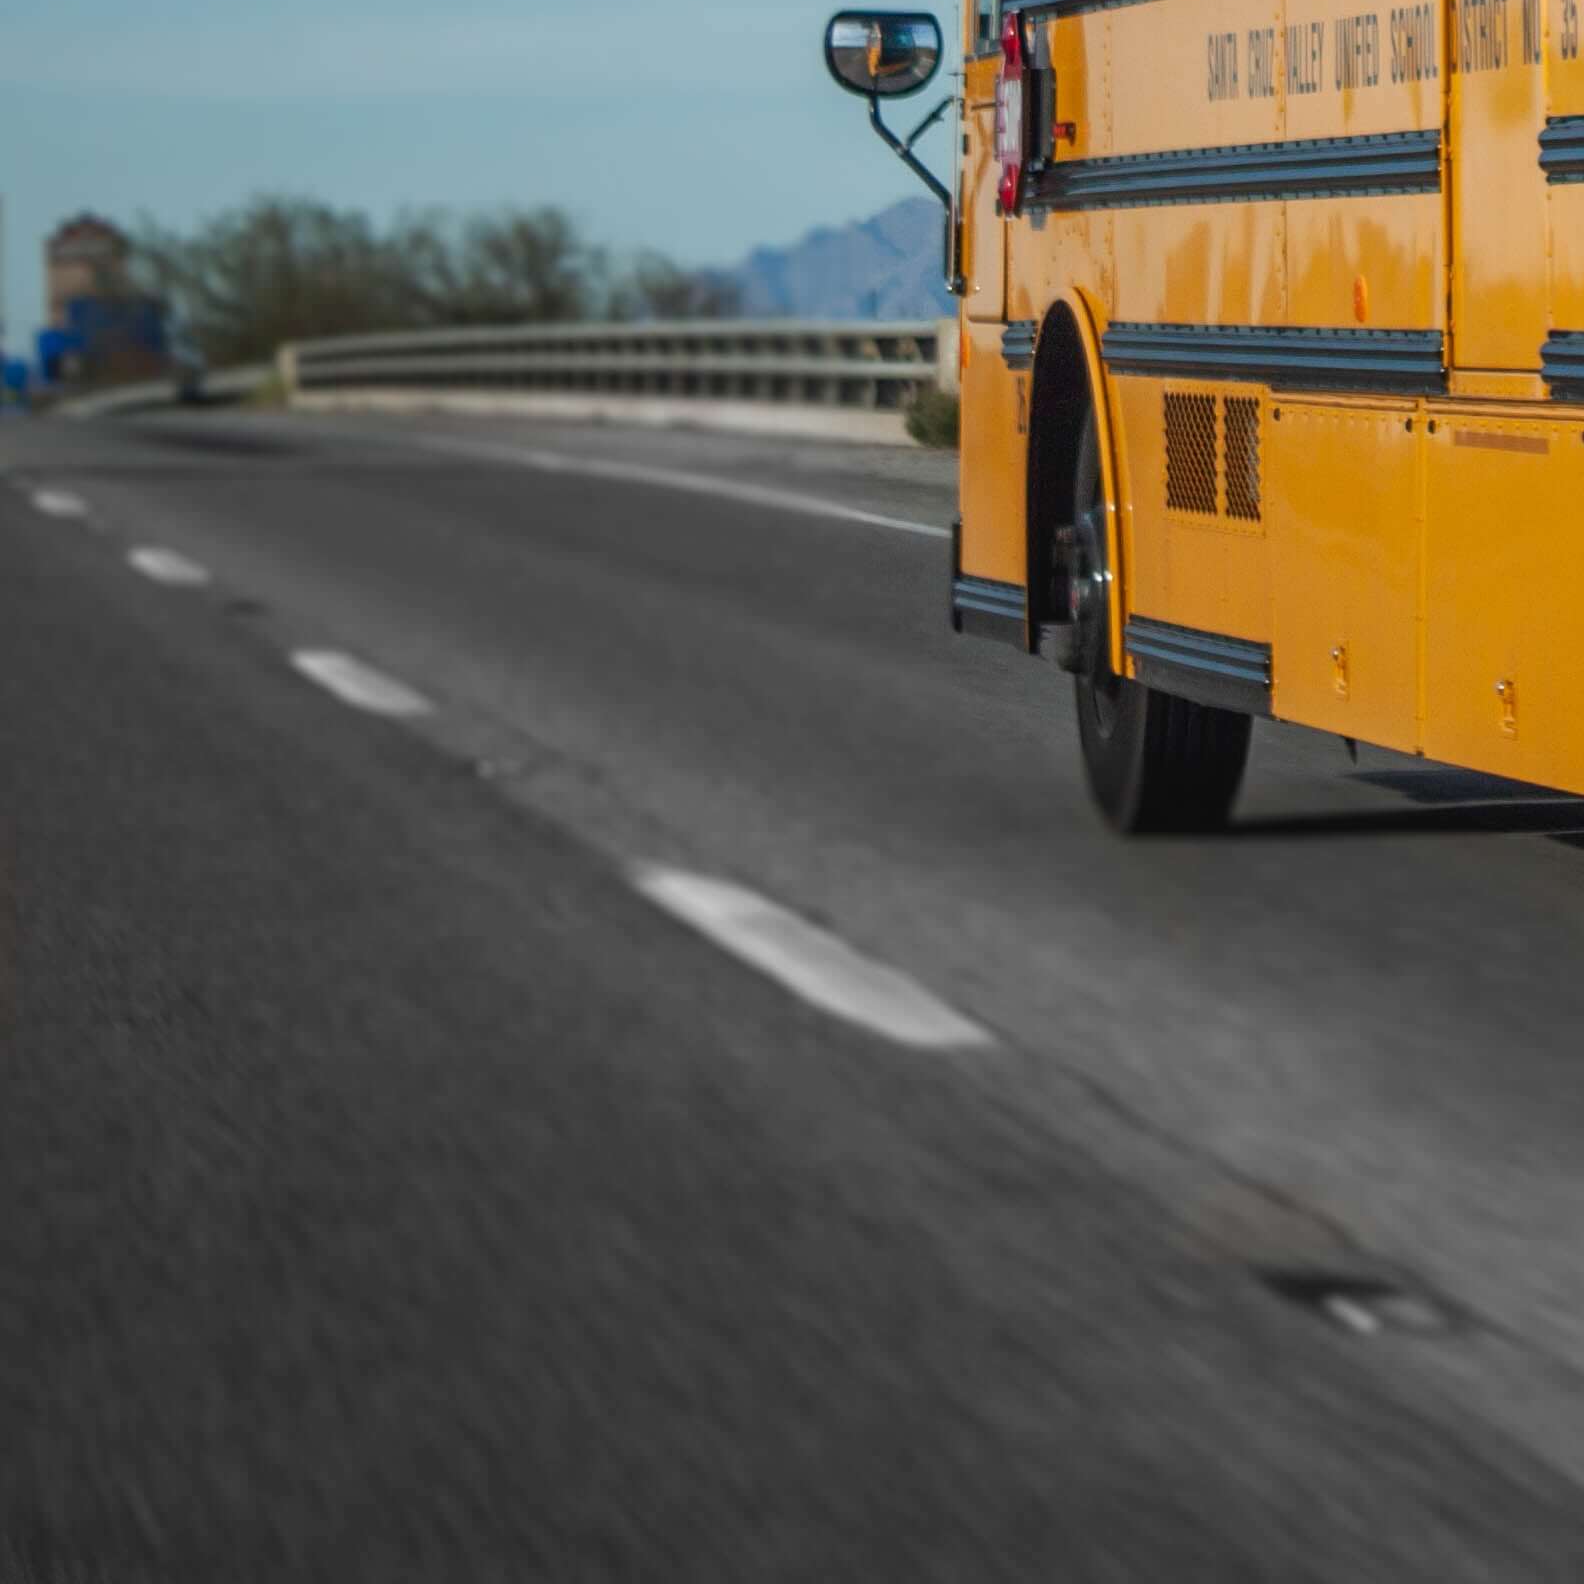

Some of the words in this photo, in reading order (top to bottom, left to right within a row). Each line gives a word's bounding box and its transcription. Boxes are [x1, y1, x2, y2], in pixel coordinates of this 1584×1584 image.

[1207, 31, 1238, 102] SANTA
[1248, 25, 1275, 98] CRUZ
[1285, 20, 1324, 95] VALLEY
[1335, 13, 1379, 92] UNIFIED
[1390, 2, 1438, 84] SCHOOL
